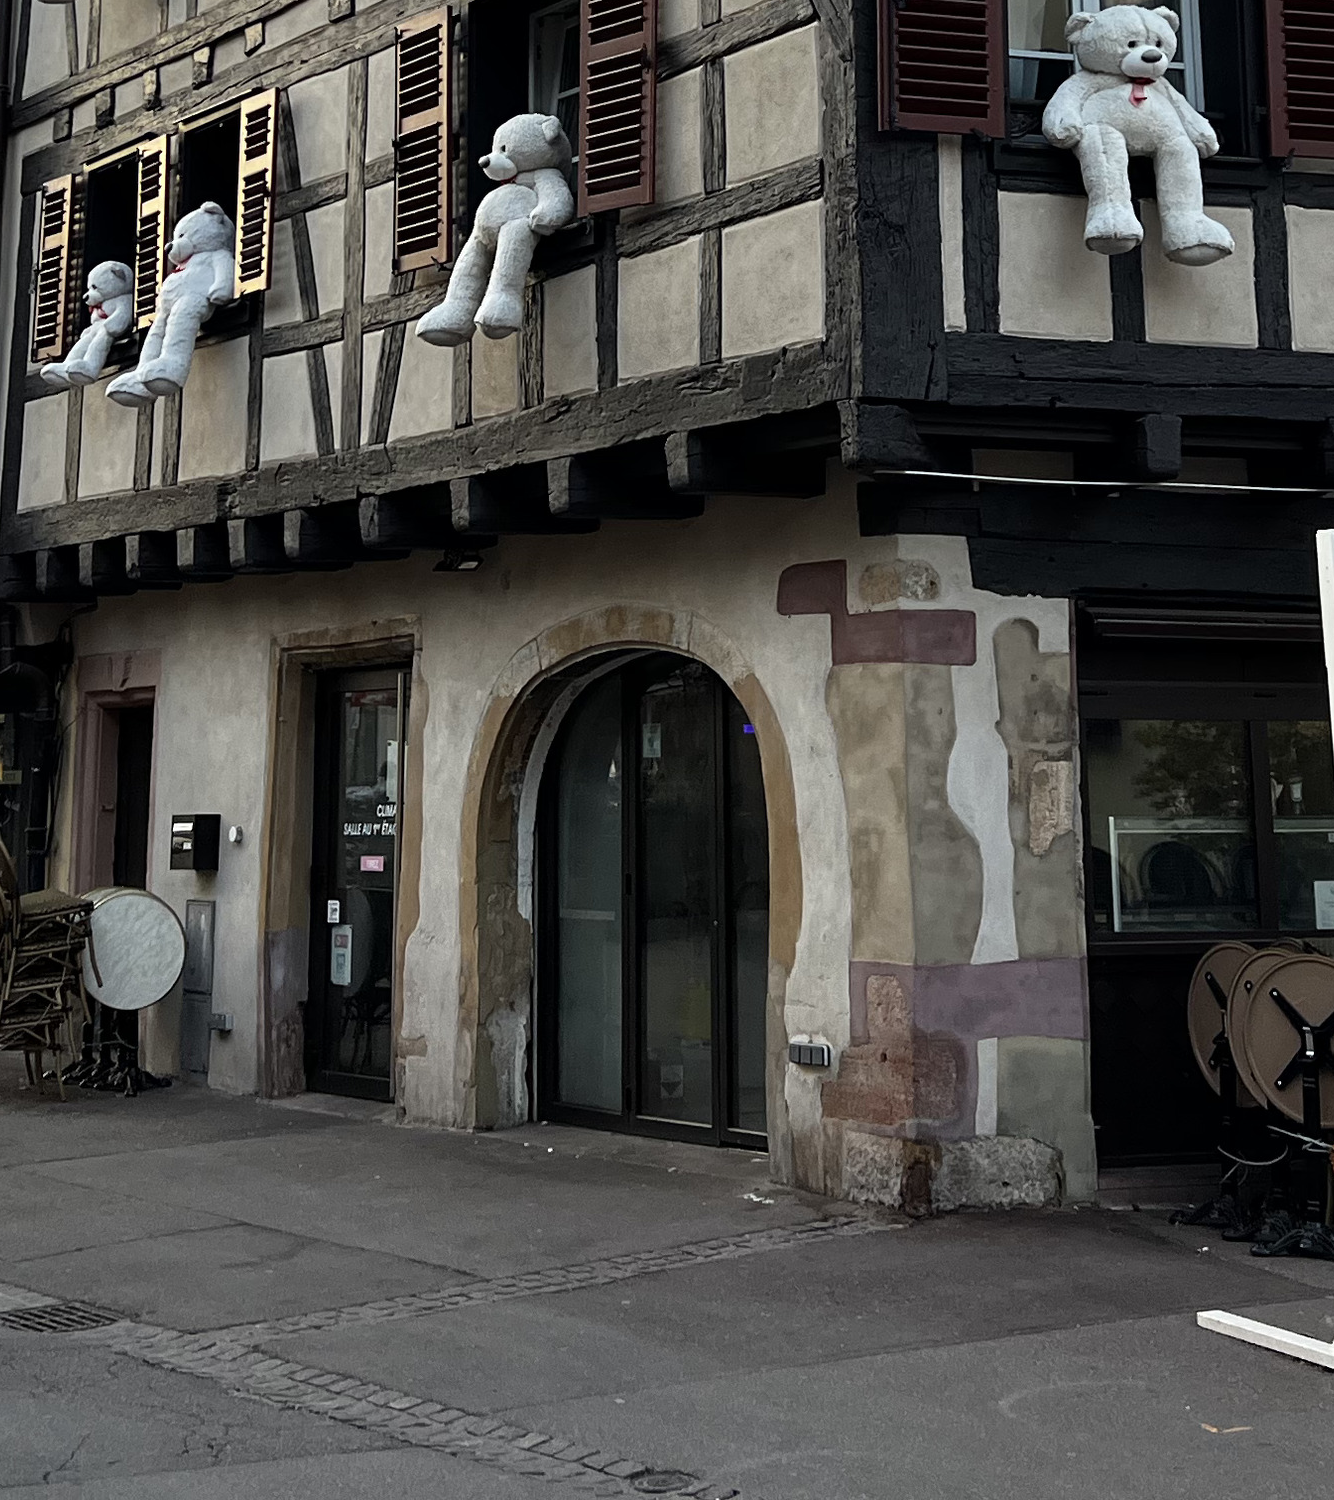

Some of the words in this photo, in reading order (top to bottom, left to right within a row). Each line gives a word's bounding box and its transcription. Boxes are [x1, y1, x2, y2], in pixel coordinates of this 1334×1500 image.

[376, 804, 397, 817] CLIMA
[343, 822, 362, 836] SALLE
[362, 822, 372, 836] AU
[381, 819, 397, 836] ÉTA
